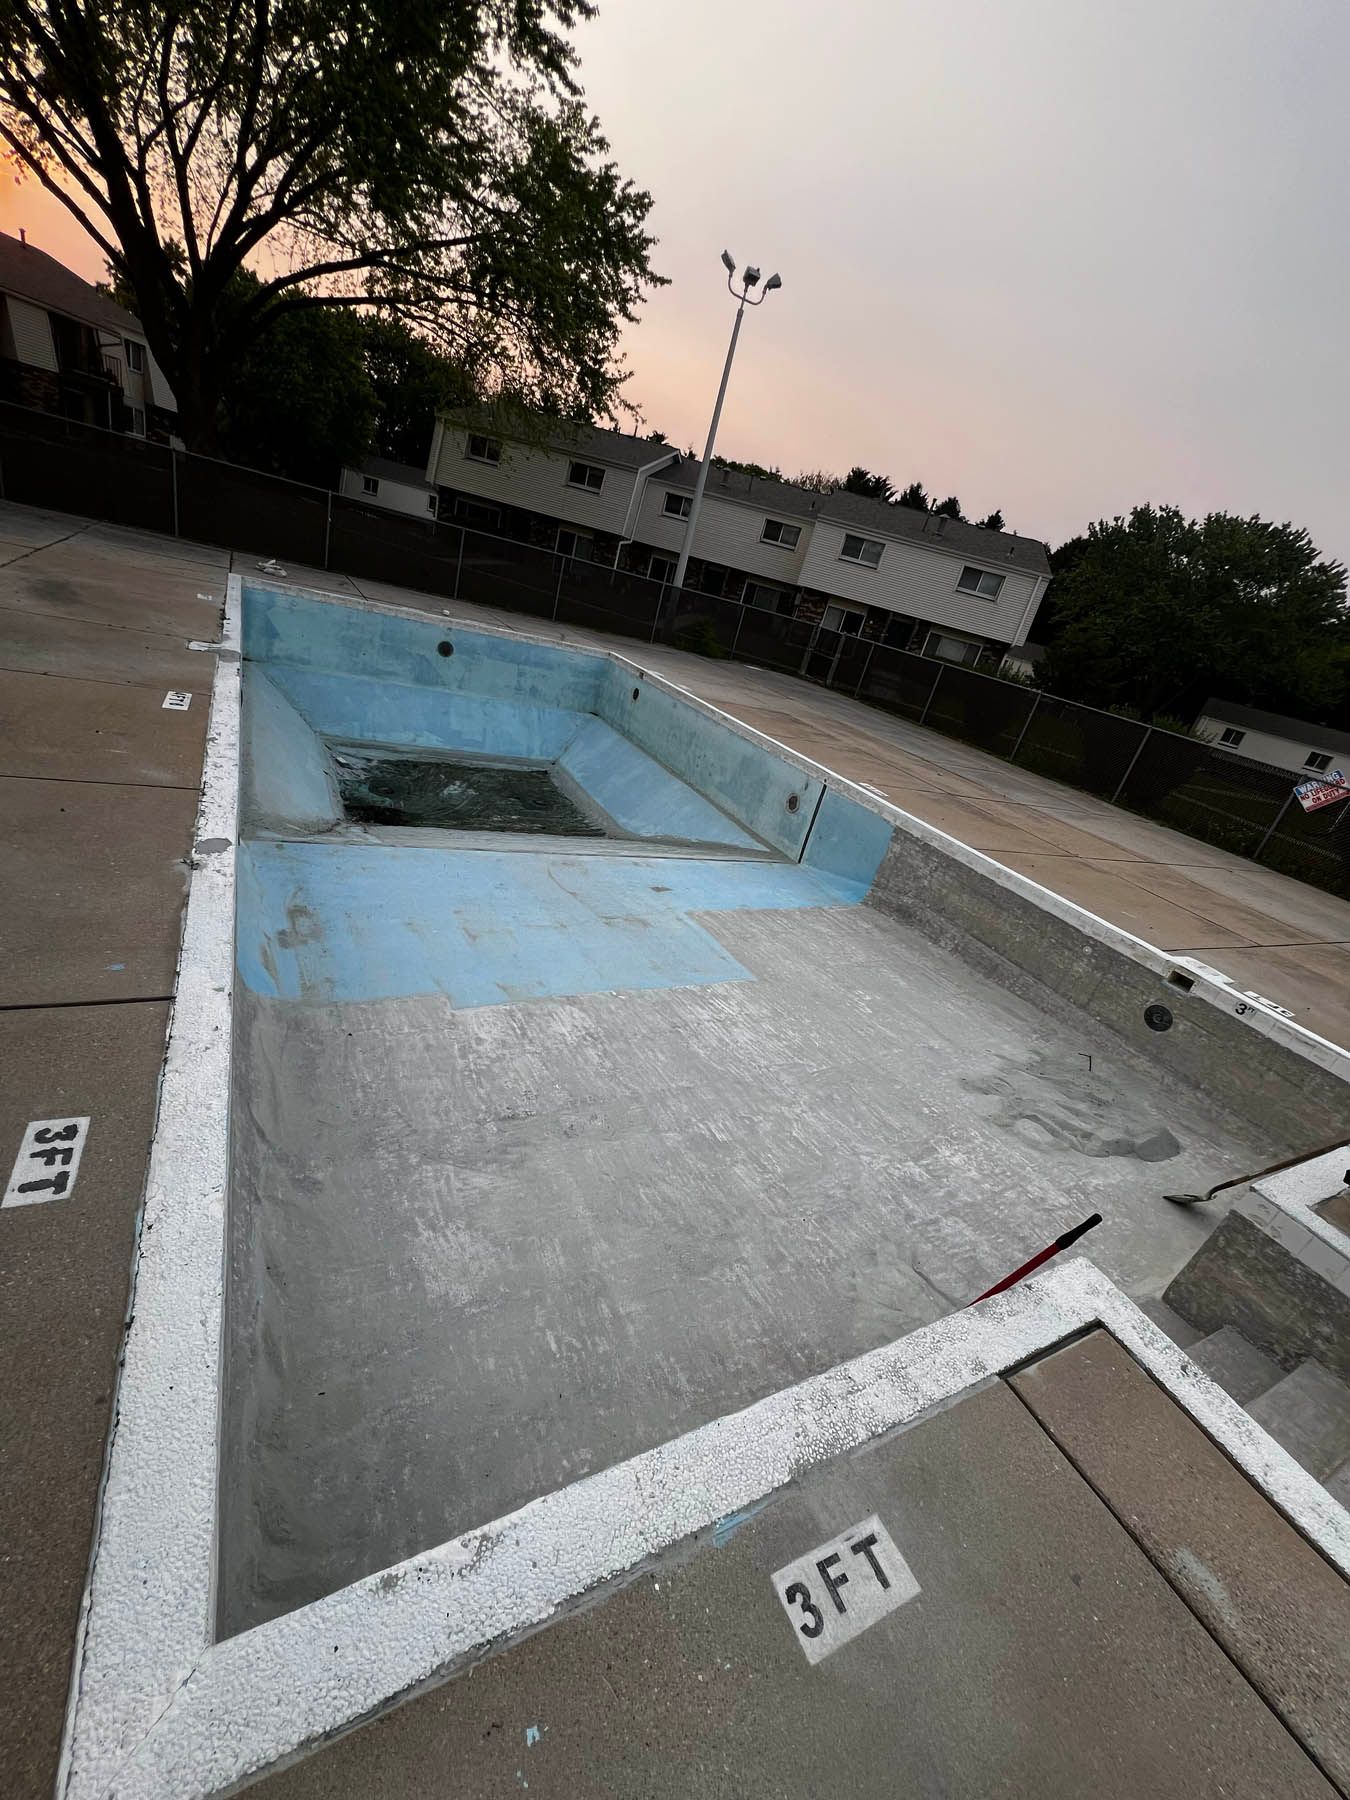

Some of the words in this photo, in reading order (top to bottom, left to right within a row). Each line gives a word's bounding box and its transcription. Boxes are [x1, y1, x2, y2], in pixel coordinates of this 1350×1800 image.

[1300, 793, 1310, 801] NO
[1311, 778, 1346, 797] LIFEGURD
[1312, 796, 1322, 804] ON
[1323, 788, 1341, 800] DUTY
[17, 1123, 79, 1195] 3FT
